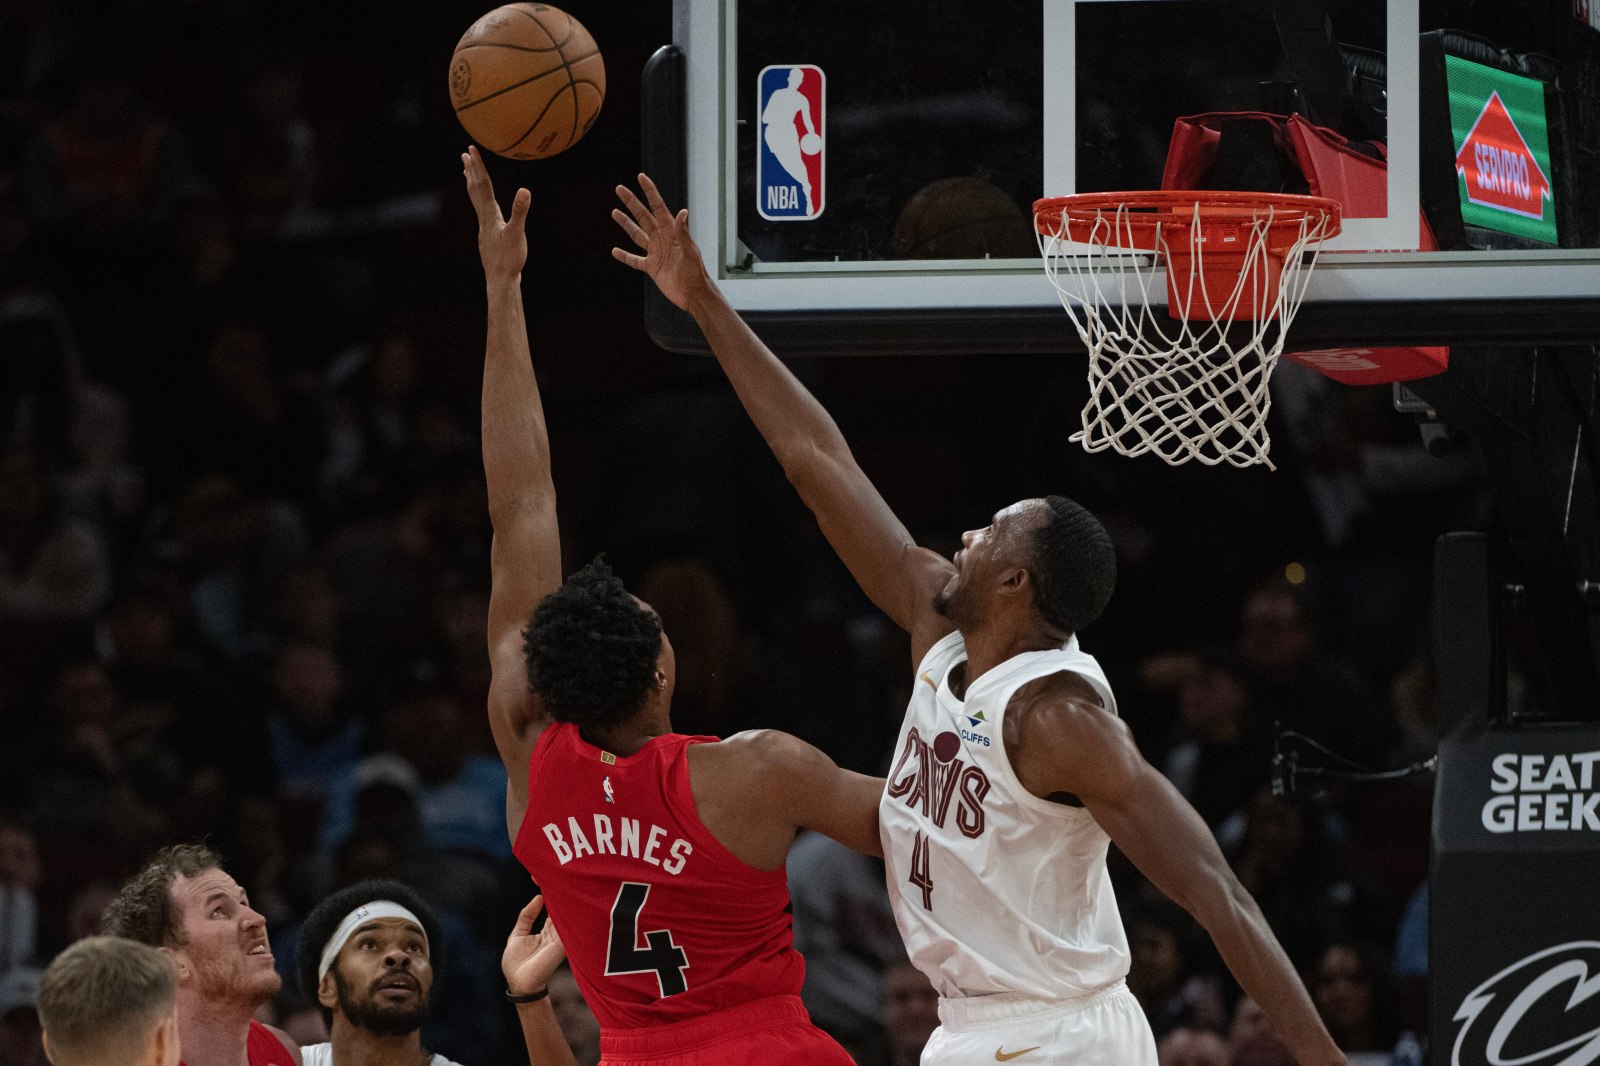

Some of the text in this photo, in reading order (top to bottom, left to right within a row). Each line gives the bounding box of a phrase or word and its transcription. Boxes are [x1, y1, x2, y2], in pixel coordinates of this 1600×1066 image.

[767, 185, 799, 209] NBA
[1474, 141, 1531, 201] SERVPRO
[961, 729, 990, 747] CLIFFS
[888, 726, 991, 839] CAVS
[1490, 751, 1600, 793] SEAT
[1481, 792, 1600, 834] GEEK
[542, 813, 693, 876] BARNES
[908, 829, 933, 912] 4
[604, 881, 690, 999] 4
